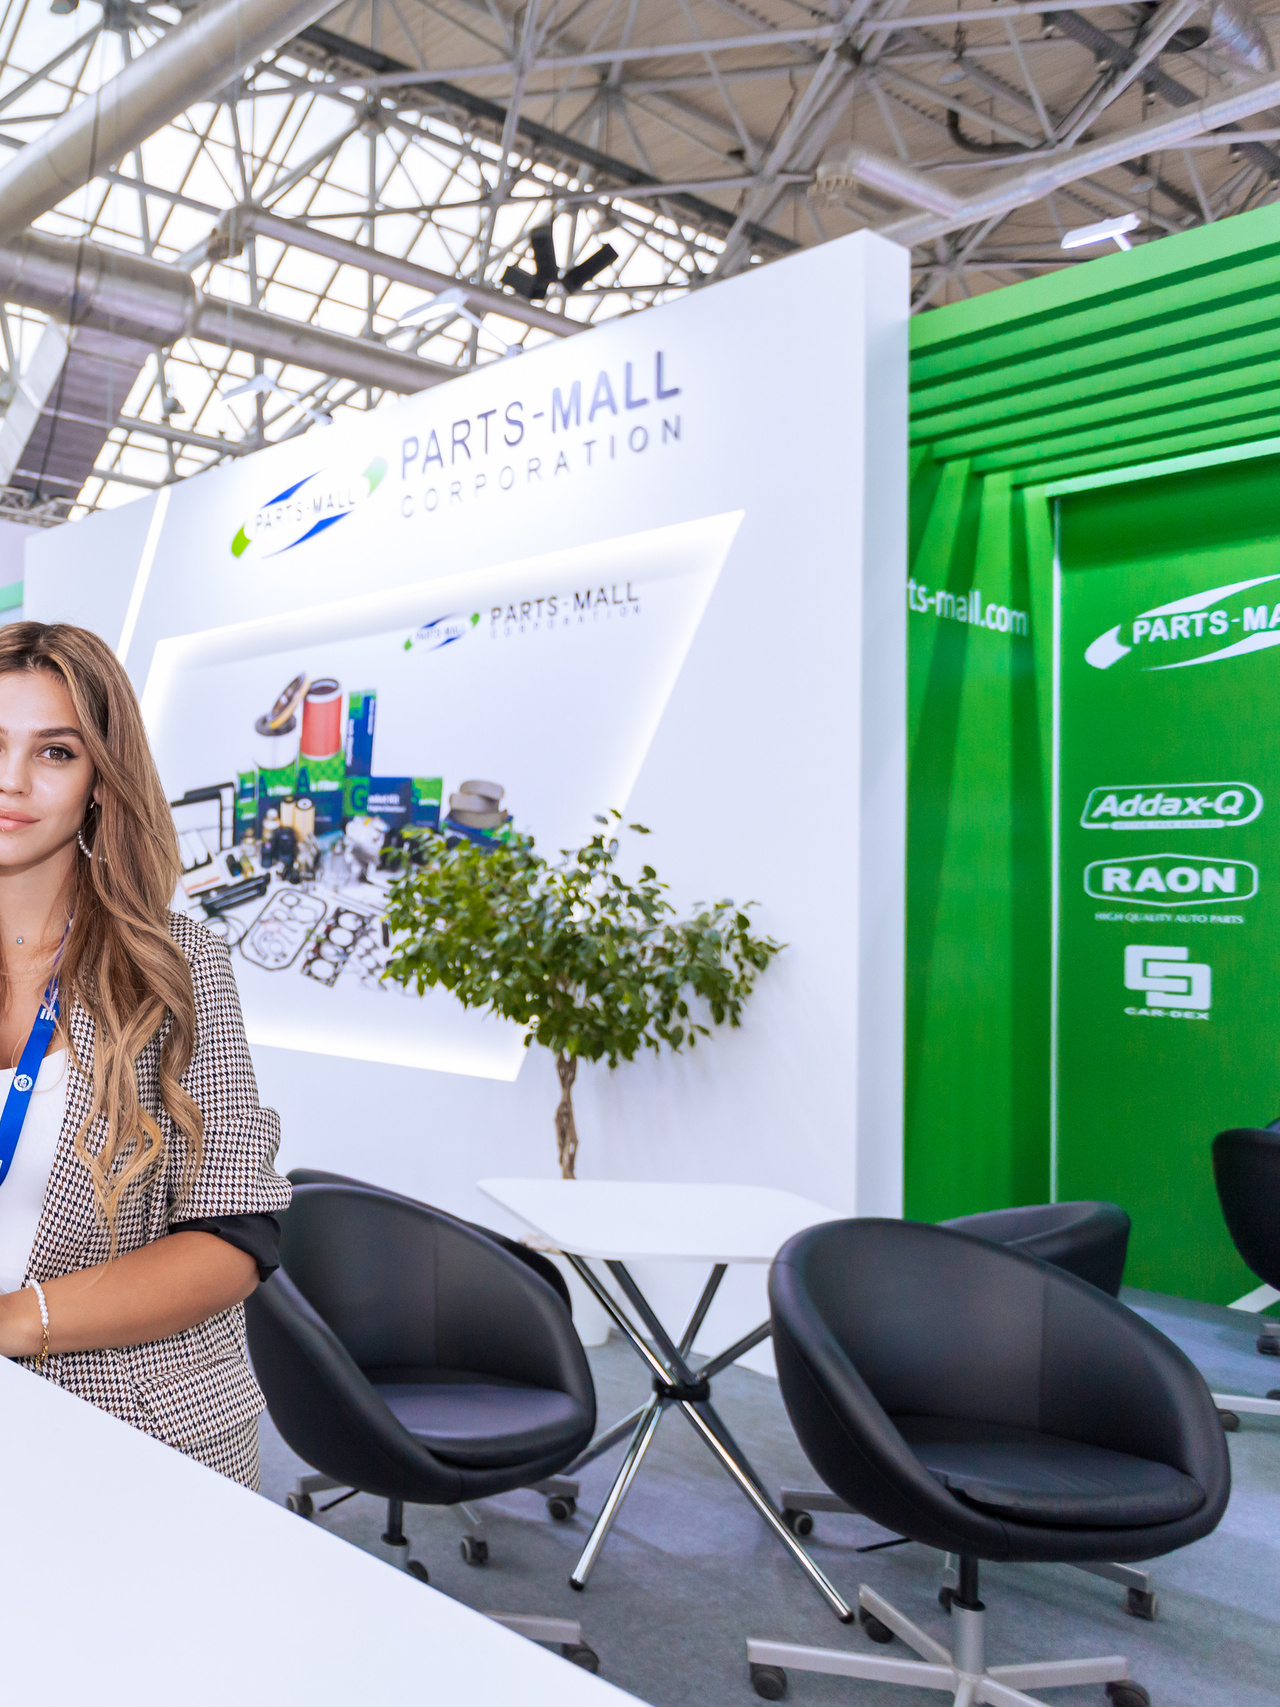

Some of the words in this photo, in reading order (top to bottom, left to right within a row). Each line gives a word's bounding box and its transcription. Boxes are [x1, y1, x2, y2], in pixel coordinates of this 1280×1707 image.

[401, 350, 682, 481] PARTS-MALL
[401, 414, 682, 519] CORPORATION
[254, 486, 356, 533] PARTS-MALL
[490, 582, 640, 626] PARTS-MALL
[1091, 790, 1245, 818] Addax-Q
[1102, 866, 1237, 893] RAON
[1094, 911, 1124, 921] HIGH
[1125, 912, 1172, 923] QUALITY
[1175, 914, 1208, 923] AUTO
[1209, 914, 1244, 924] PARTS
[1123, 1006, 1209, 1020] CAR-DEX
